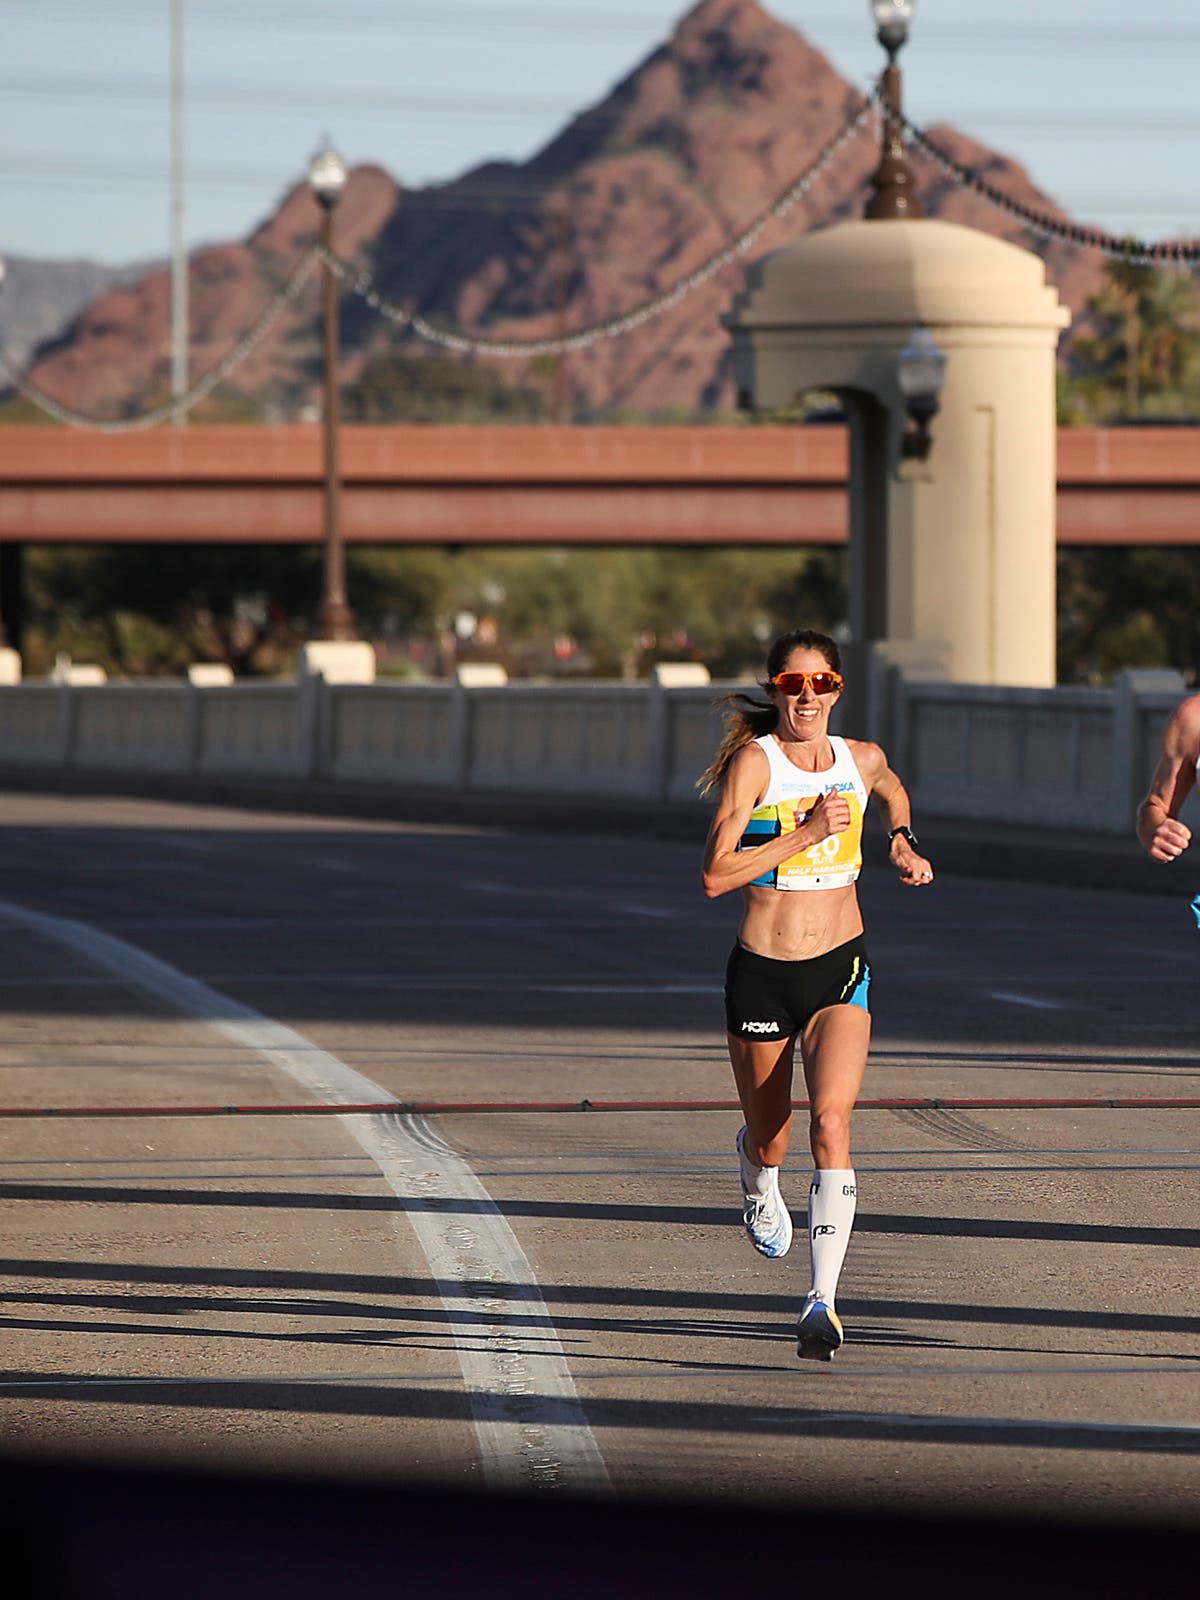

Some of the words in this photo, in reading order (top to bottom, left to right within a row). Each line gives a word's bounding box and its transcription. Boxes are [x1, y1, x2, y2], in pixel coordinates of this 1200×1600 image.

[825, 782, 855, 793] HOKA
[806, 834, 840, 858] 20
[742, 1021, 779, 1033] HOKA
